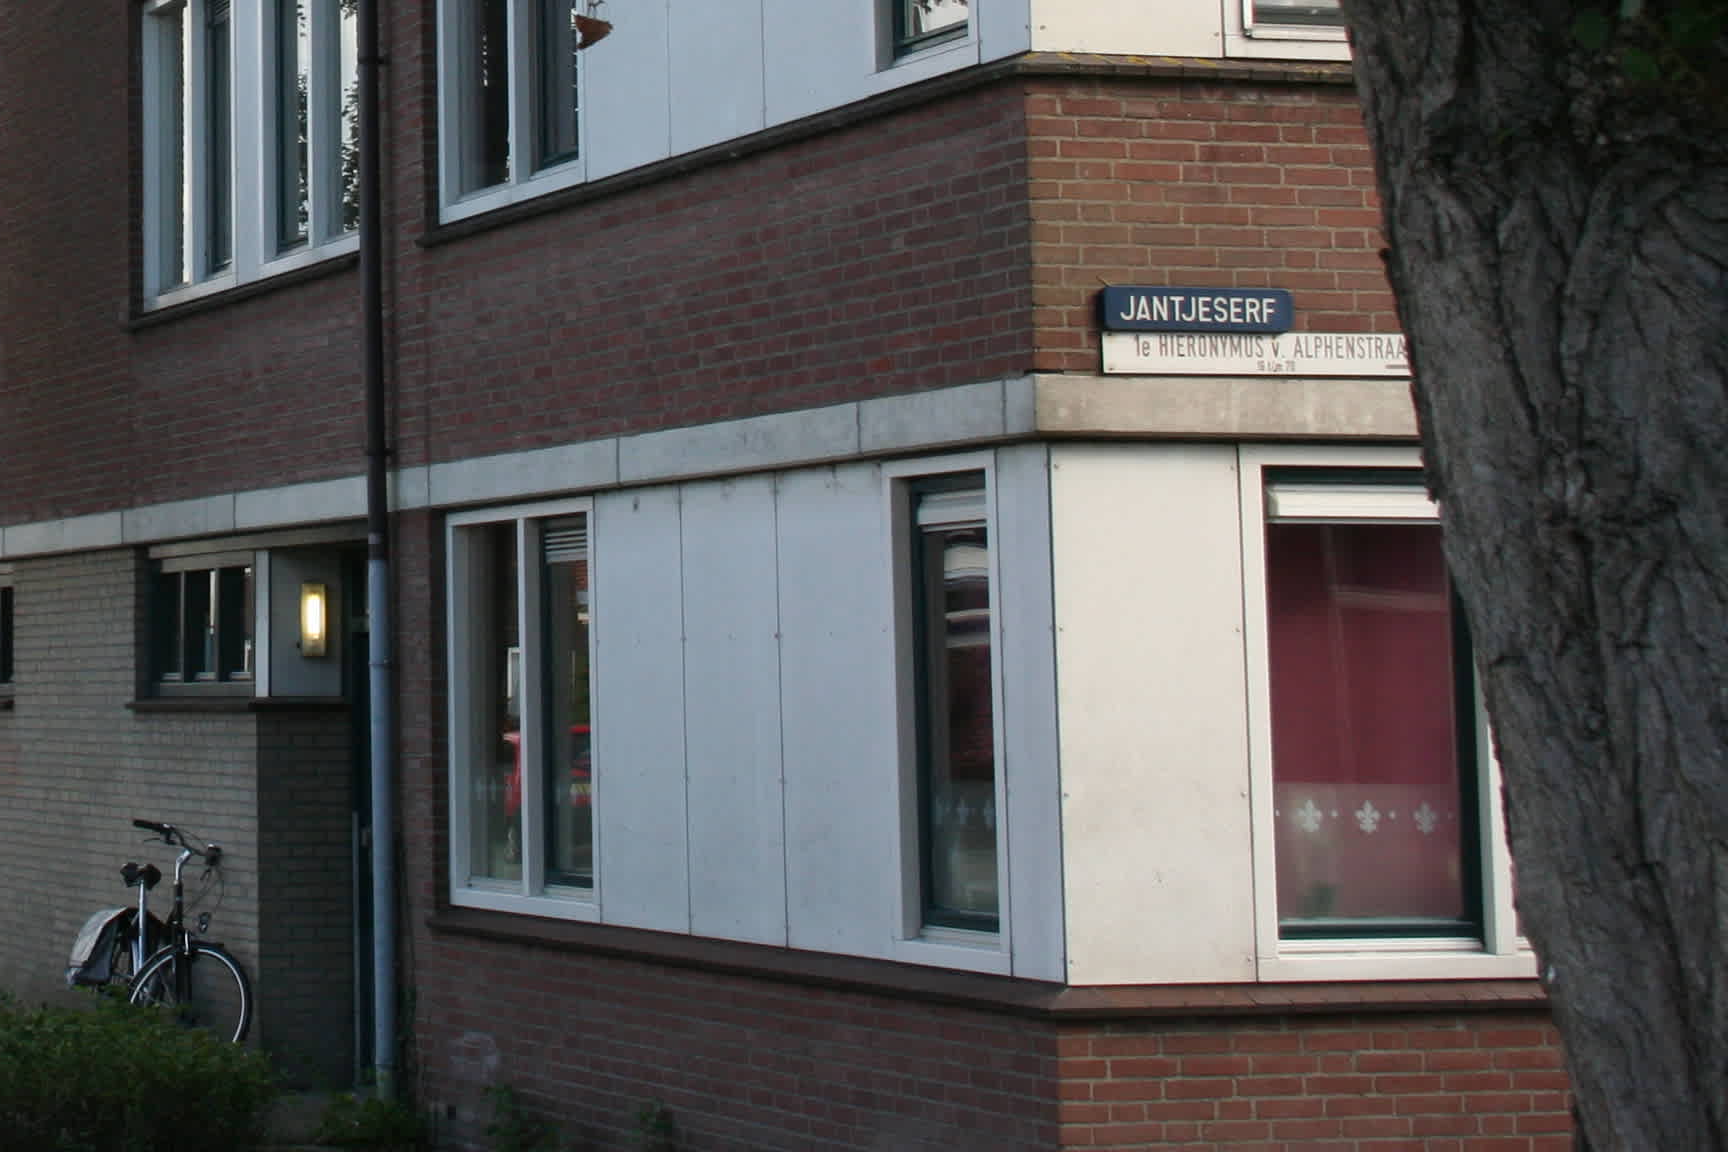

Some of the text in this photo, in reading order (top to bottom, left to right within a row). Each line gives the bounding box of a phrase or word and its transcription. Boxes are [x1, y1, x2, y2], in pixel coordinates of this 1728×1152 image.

[1119, 295, 1276, 323] JANTJESERF
[1159, 335, 1265, 358] HIERONYMUS
[1293, 335, 1409, 359] ALPHENSTRAA
